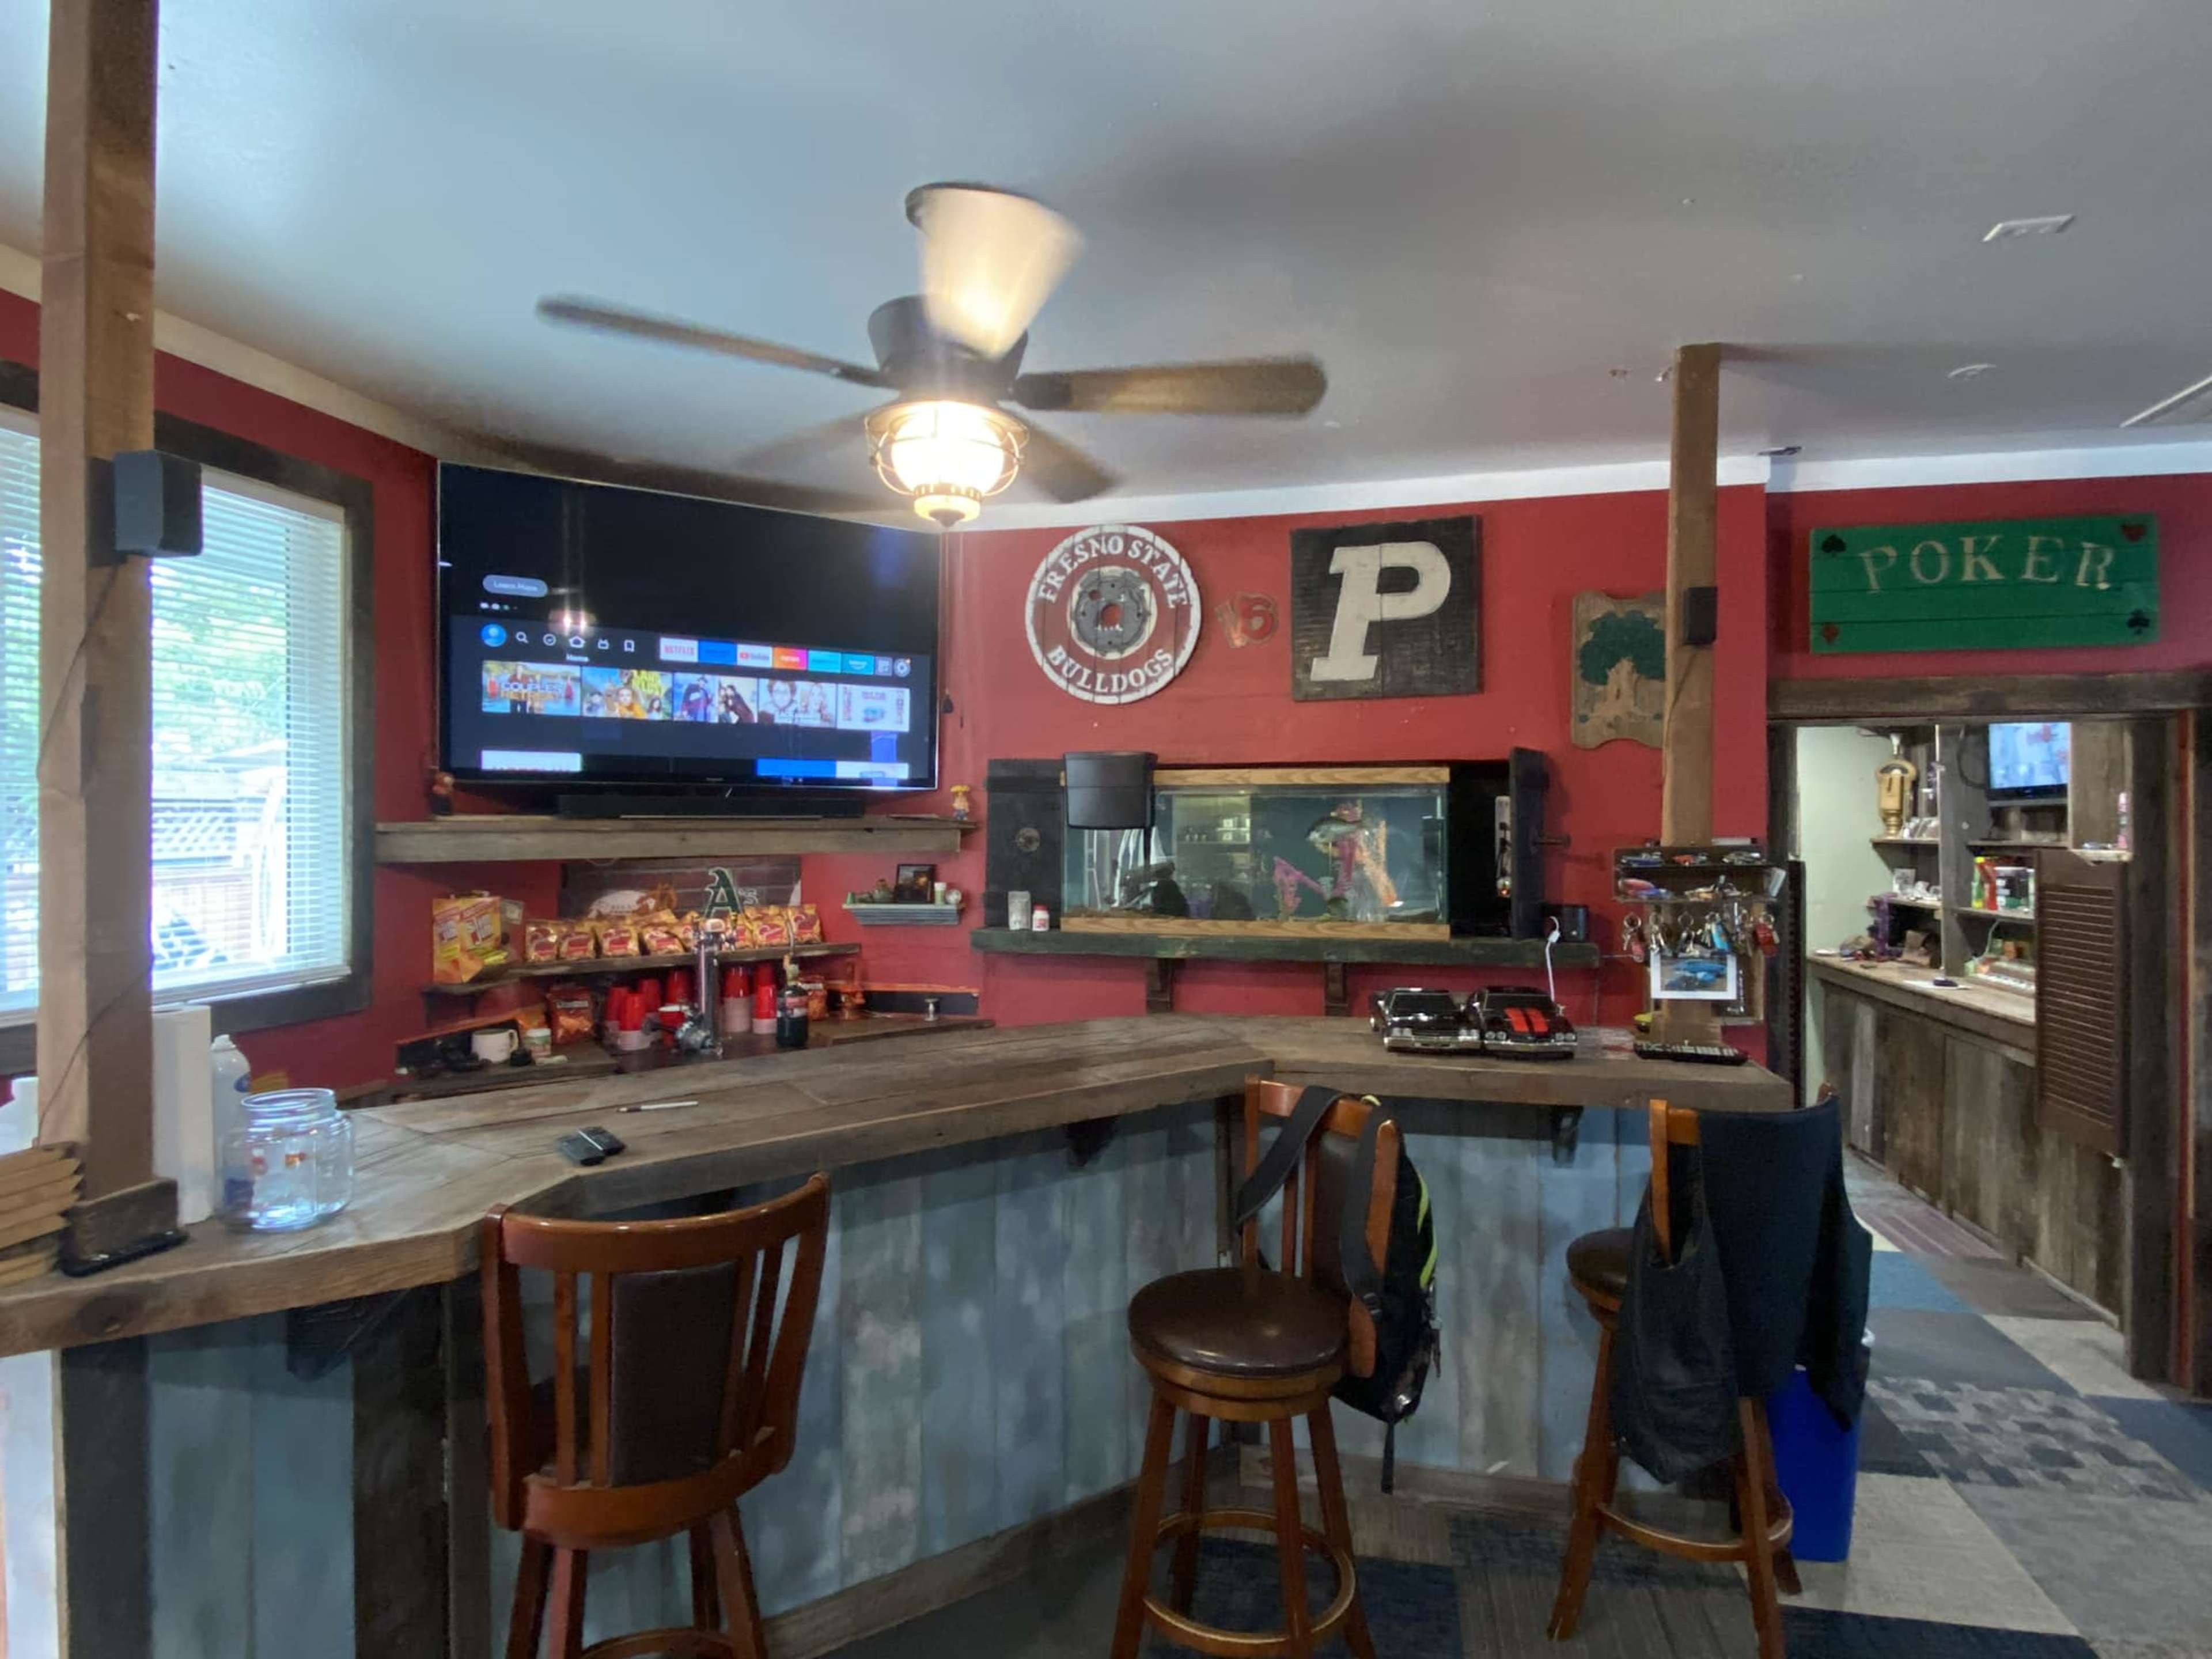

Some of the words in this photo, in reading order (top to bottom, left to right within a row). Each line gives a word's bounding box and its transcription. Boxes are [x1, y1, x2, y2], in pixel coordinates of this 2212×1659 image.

[1038, 535, 1124, 604] FRESNO
[1127, 539, 1188, 609] STATE
[1858, 535, 2115, 594] POKER
[1310, 540, 1451, 681] P
[664, 644, 695, 656] NETFLIX
[1047, 645, 1173, 692] BULLDOGS
